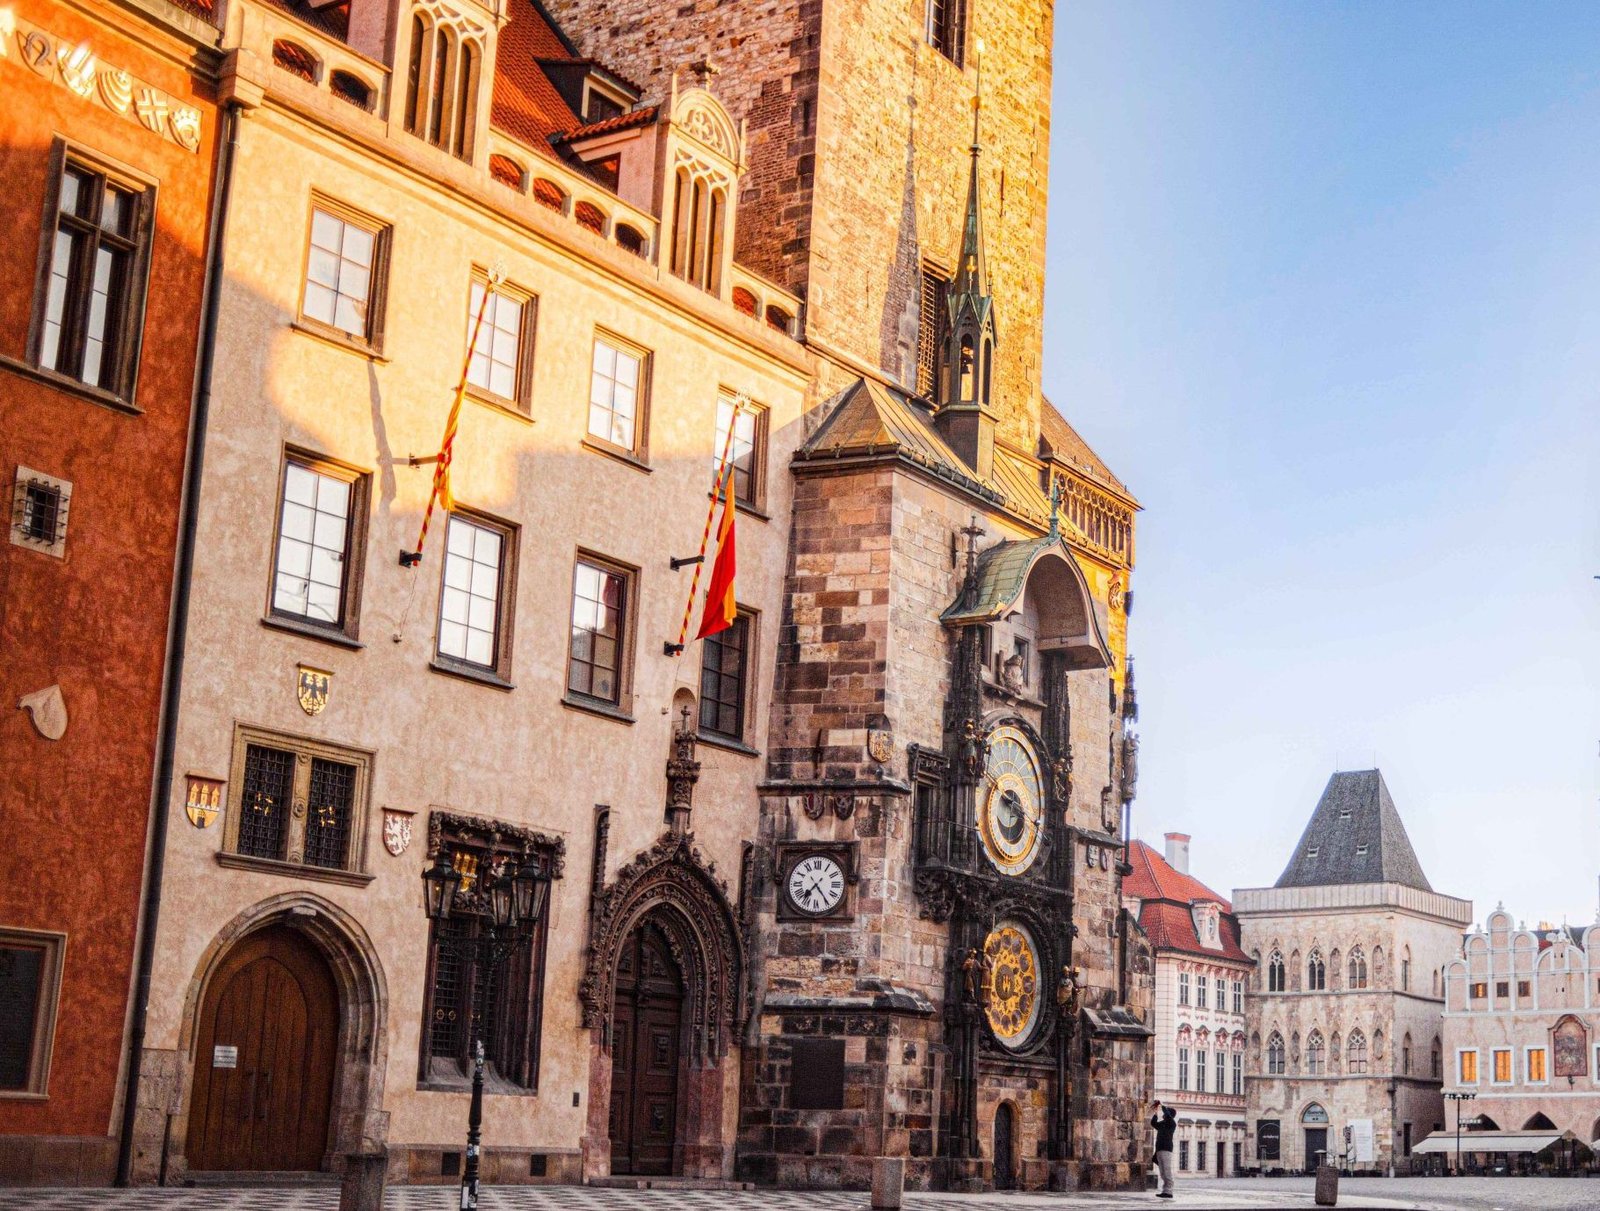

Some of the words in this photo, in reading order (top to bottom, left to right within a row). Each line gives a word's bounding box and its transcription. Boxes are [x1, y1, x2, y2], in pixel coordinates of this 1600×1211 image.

[803, 862, 812, 872] XI
[813, 860, 822, 870] XII
[824, 863, 831, 872] I
[829, 871, 839, 879] II
[813, 899, 819, 909] VI
